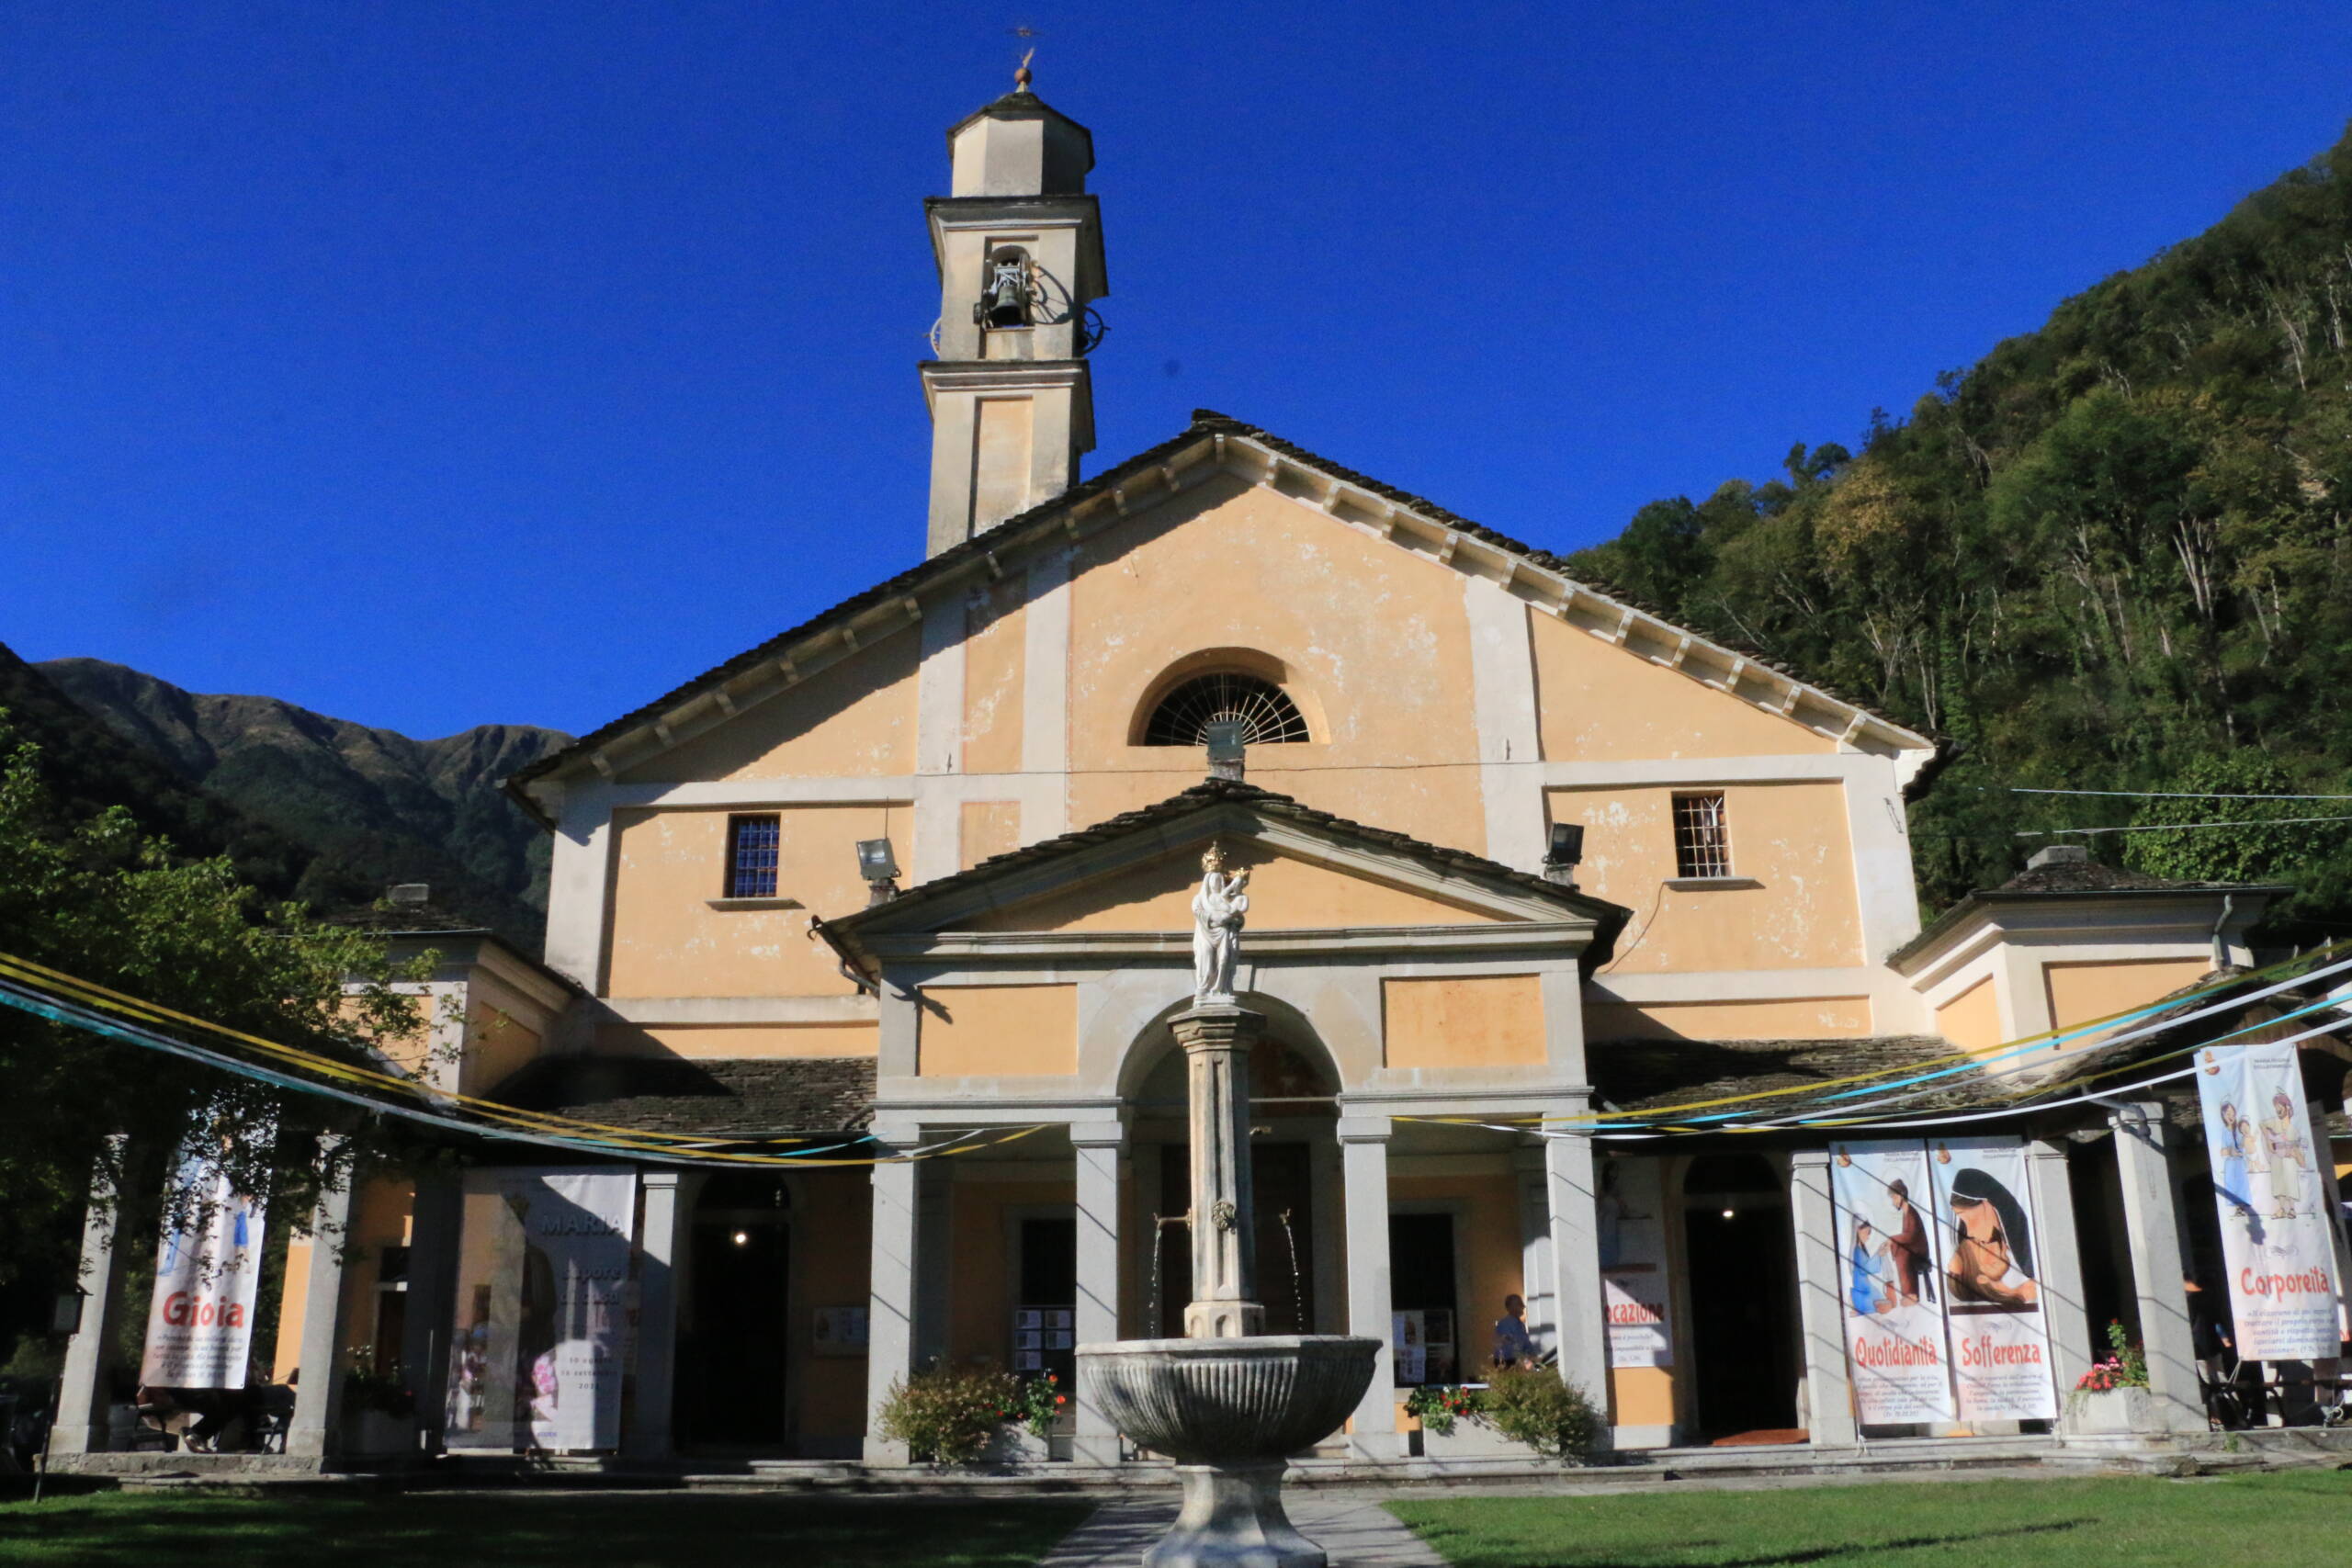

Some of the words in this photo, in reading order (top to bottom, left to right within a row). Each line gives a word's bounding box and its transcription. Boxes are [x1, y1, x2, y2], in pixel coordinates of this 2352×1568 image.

[542, 1214, 625, 1235] MARIA
[2242, 1267, 2330, 1303] Corporeità
[163, 1292, 244, 1328] Gioia
[1604, 1303, 1664, 1323] ocazione
[1855, 1336, 1938, 1369] Quotidianità
[1962, 1335, 2041, 1368] Sofferenza
